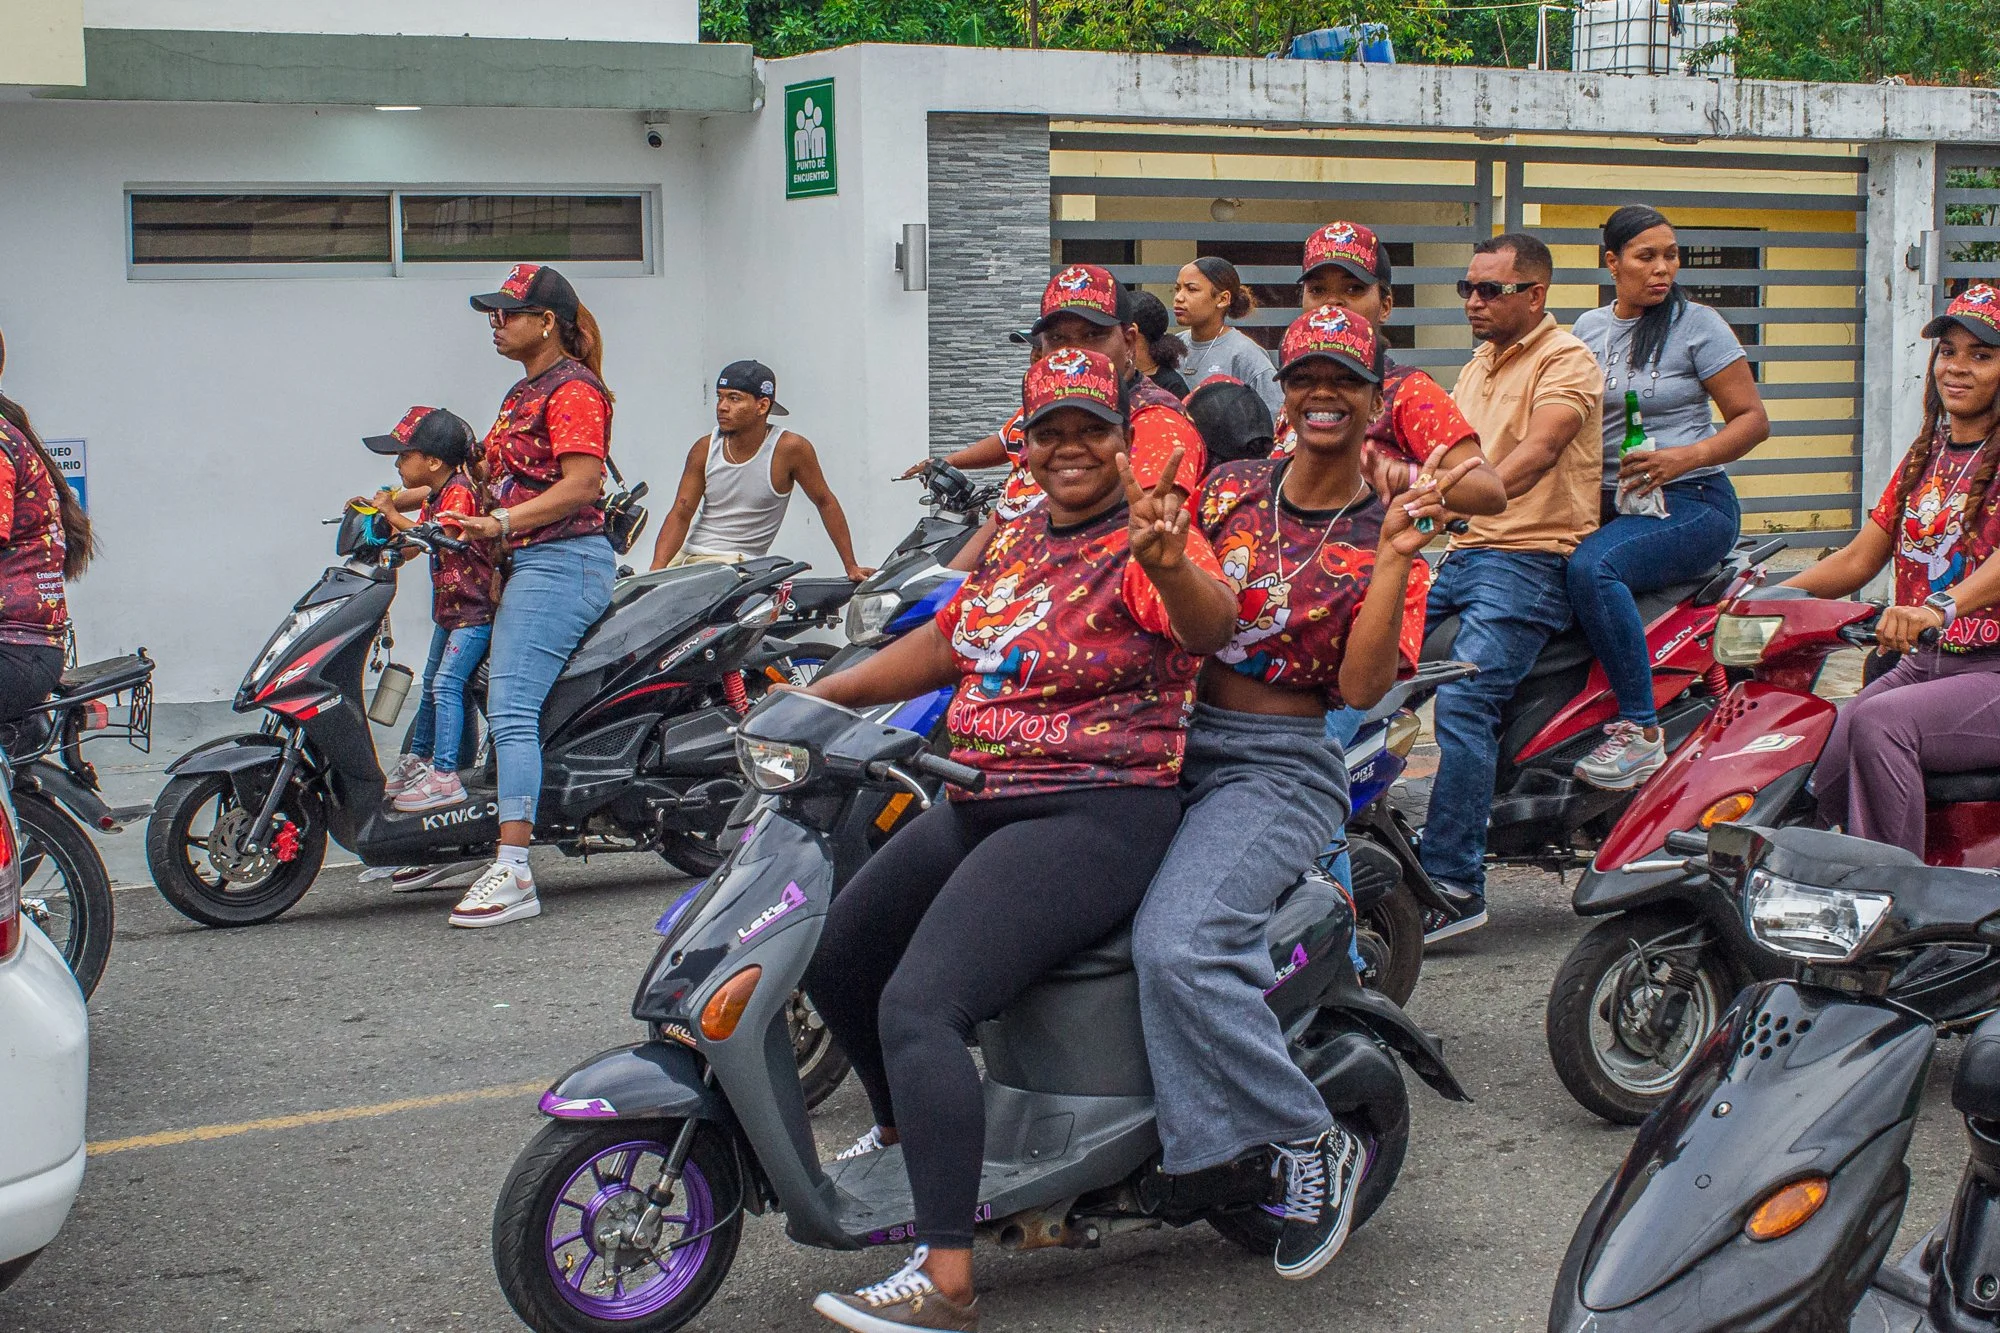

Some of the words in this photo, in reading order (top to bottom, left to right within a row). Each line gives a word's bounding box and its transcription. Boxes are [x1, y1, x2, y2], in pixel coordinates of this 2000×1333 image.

[796, 160, 816, 170] PUNTO
[817, 158, 826, 168] DE
[793, 171, 830, 184] ENCUENTRO
[1332, 250, 1351, 258] Buenos
[1352, 254, 1364, 264] Aires
[1088, 300, 1102, 309] Aires
[1320, 341, 1344, 350] Buenos
[1345, 345, 1361, 358] Aires
[1054, 388, 1063, 396] de
[1065, 386, 1089, 395] Buenos
[1090, 388, 1106, 400] Aires
[973, 737, 1006, 756] Aires
[1350, 761, 1375, 782] ORT
[889, 1203, 992, 1240] SUKI
